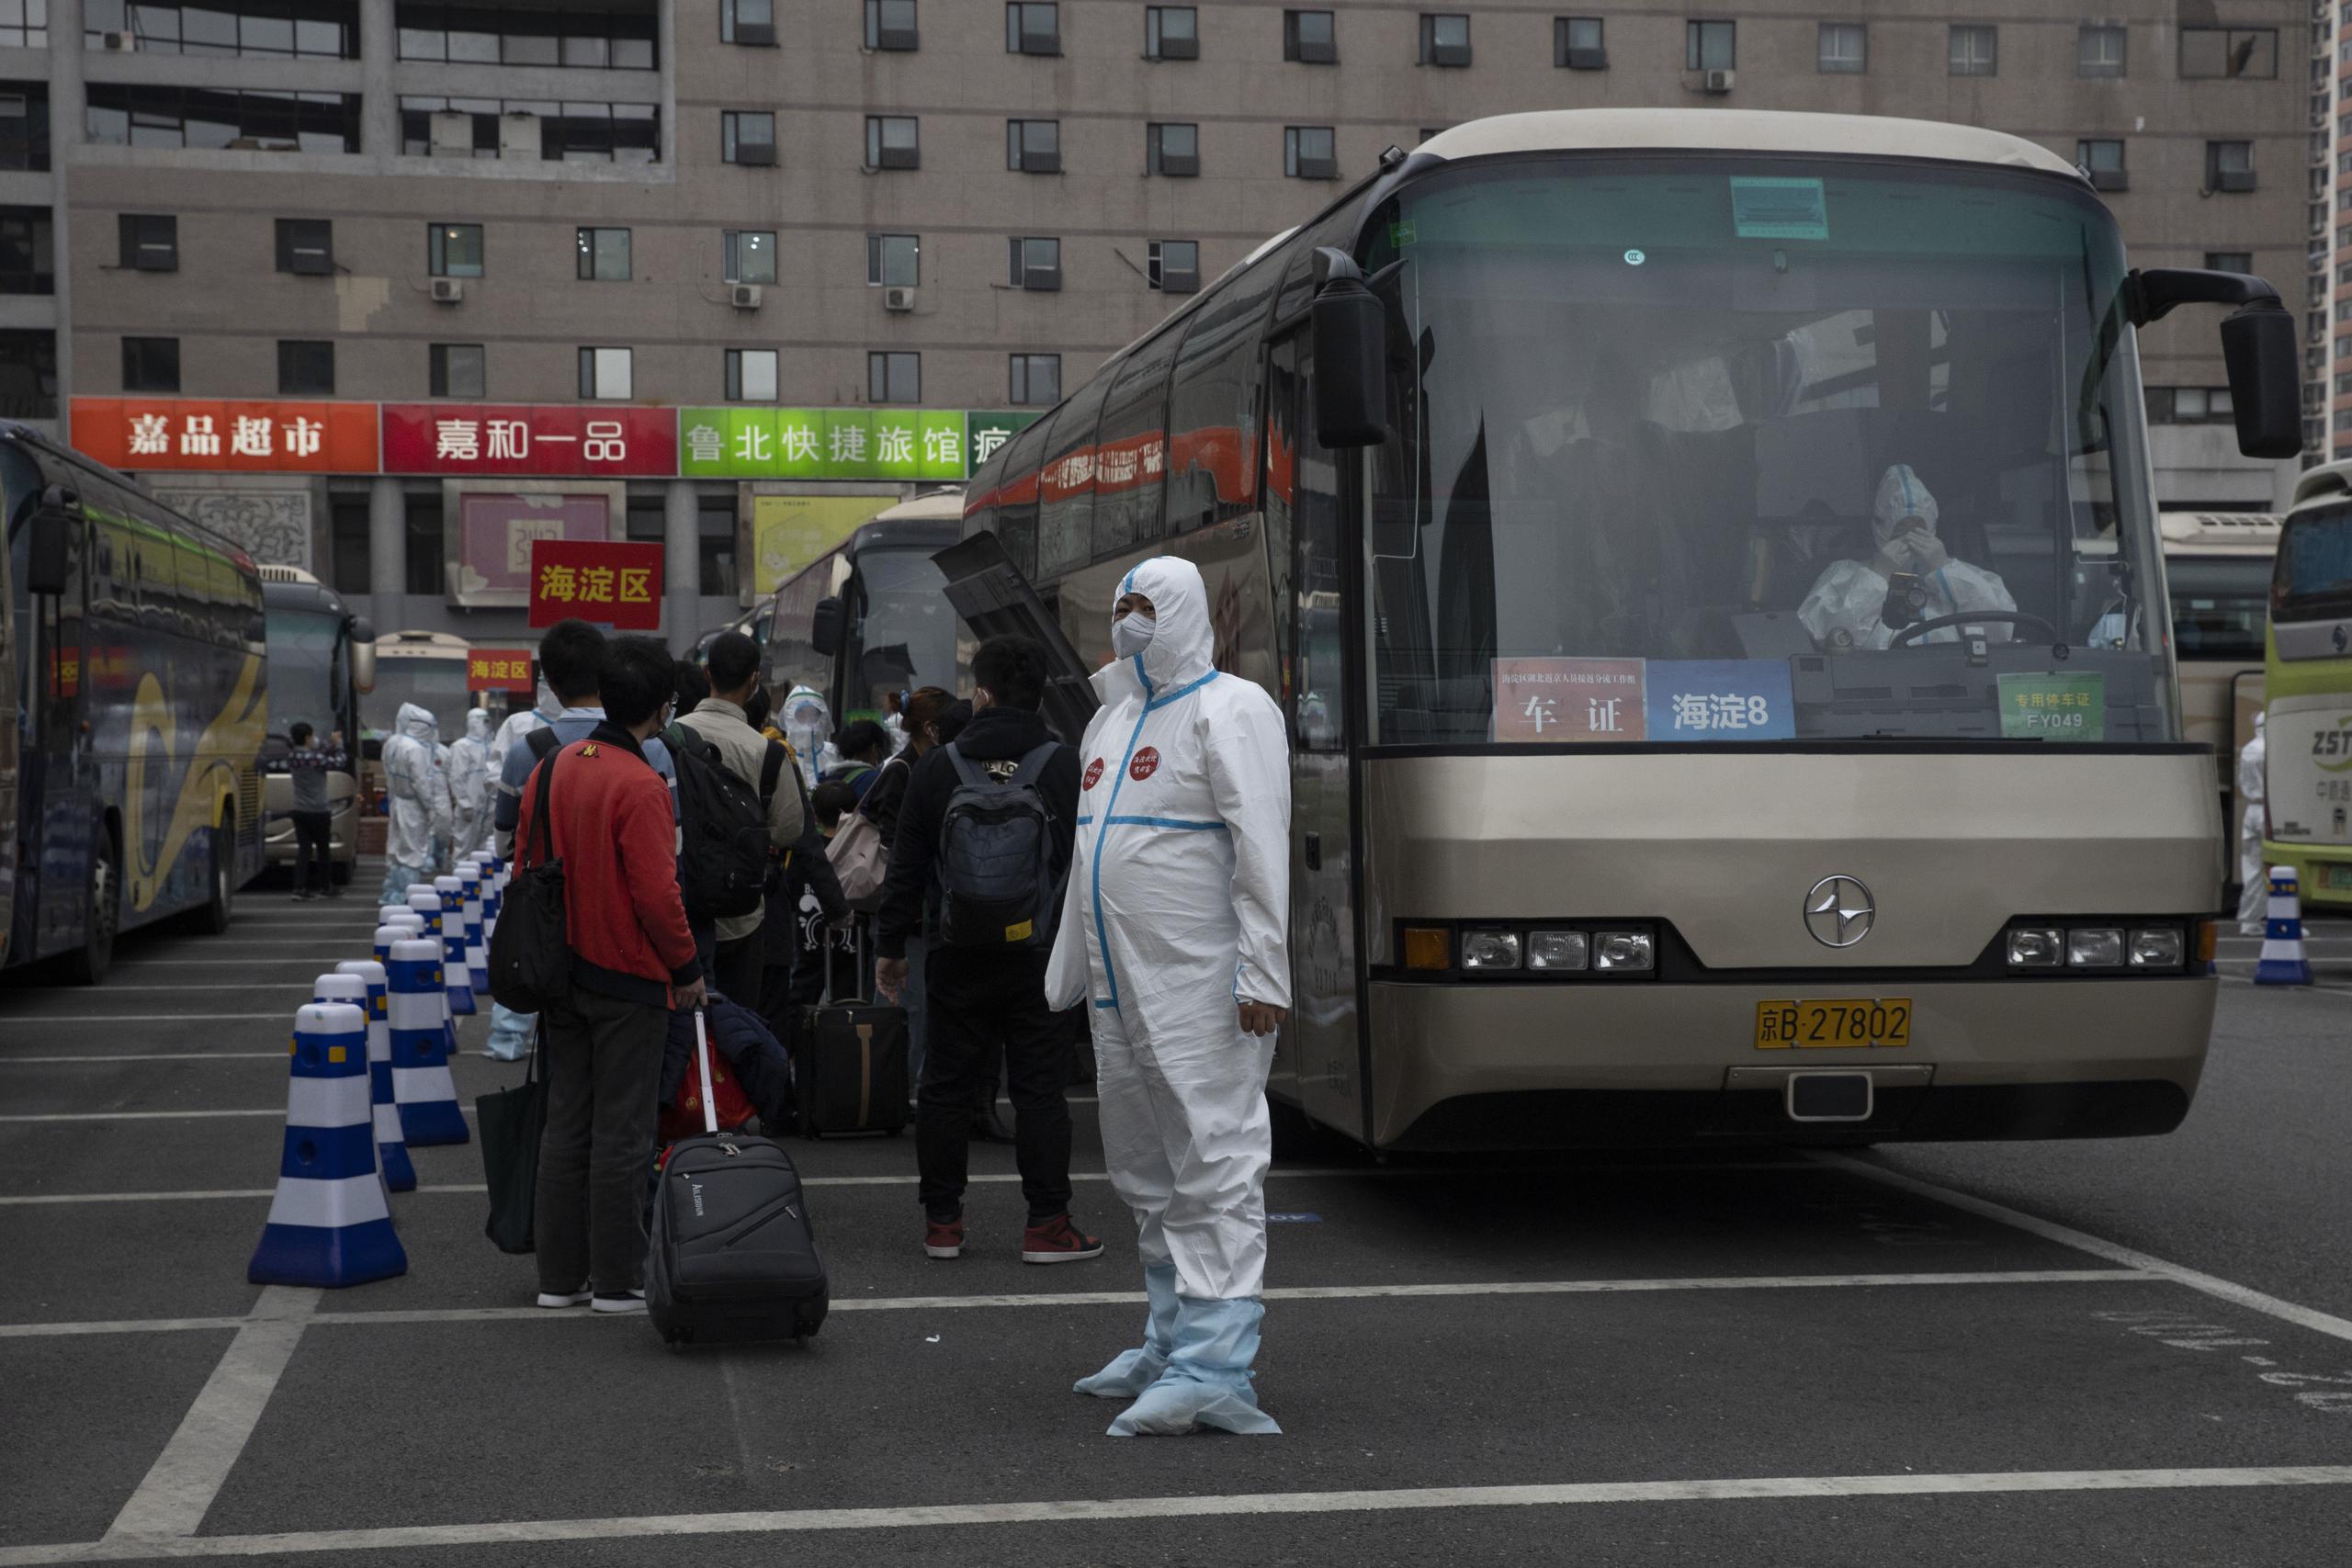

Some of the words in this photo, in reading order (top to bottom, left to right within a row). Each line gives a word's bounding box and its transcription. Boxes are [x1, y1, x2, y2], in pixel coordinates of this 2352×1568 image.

[128, 415, 324, 457] 嘉品超市
[435, 420, 626, 460] 嘉和一品
[686, 423, 961, 465] 鲁北快捷旅馆
[538, 564, 653, 604] 海淀区
[470, 660, 528, 680] 海淀区
[1671, 694, 1770, 730] 海淀8
[2014, 692, 2091, 707] 专用停车证
[2027, 713, 2084, 728] FY049
